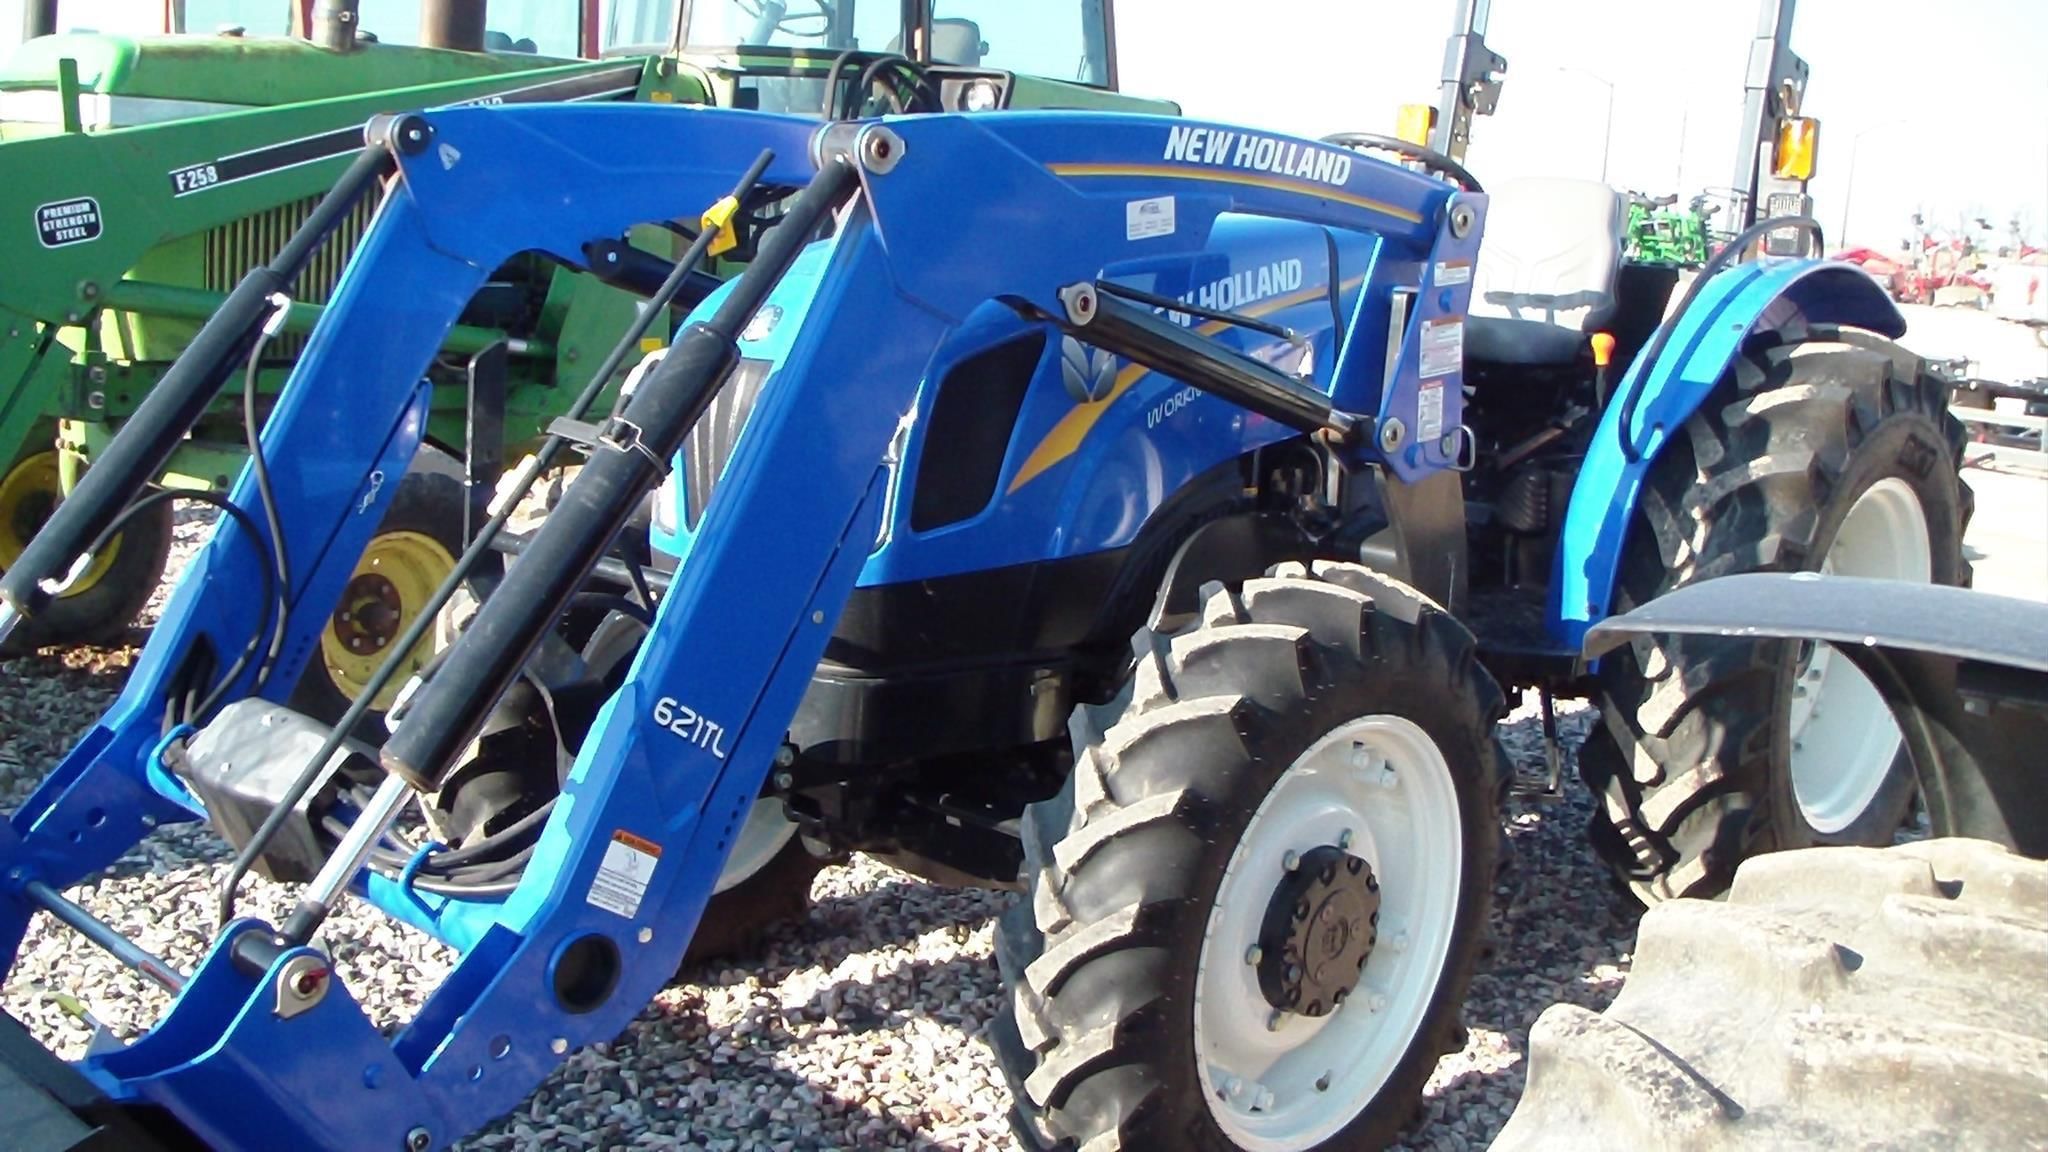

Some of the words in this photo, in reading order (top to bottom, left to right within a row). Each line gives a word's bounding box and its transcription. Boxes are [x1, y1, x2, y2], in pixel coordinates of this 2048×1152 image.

[1163, 126, 1234, 165] NEW
[1232, 135, 1351, 186] HOLLAND
[42, 213, 96, 232] STRENGTH
[43, 202, 91, 219] PREMIUM
[55, 226, 88, 241] STEEL
[1200, 258, 1302, 312] HOLLAND
[653, 696, 725, 759] 621TL
